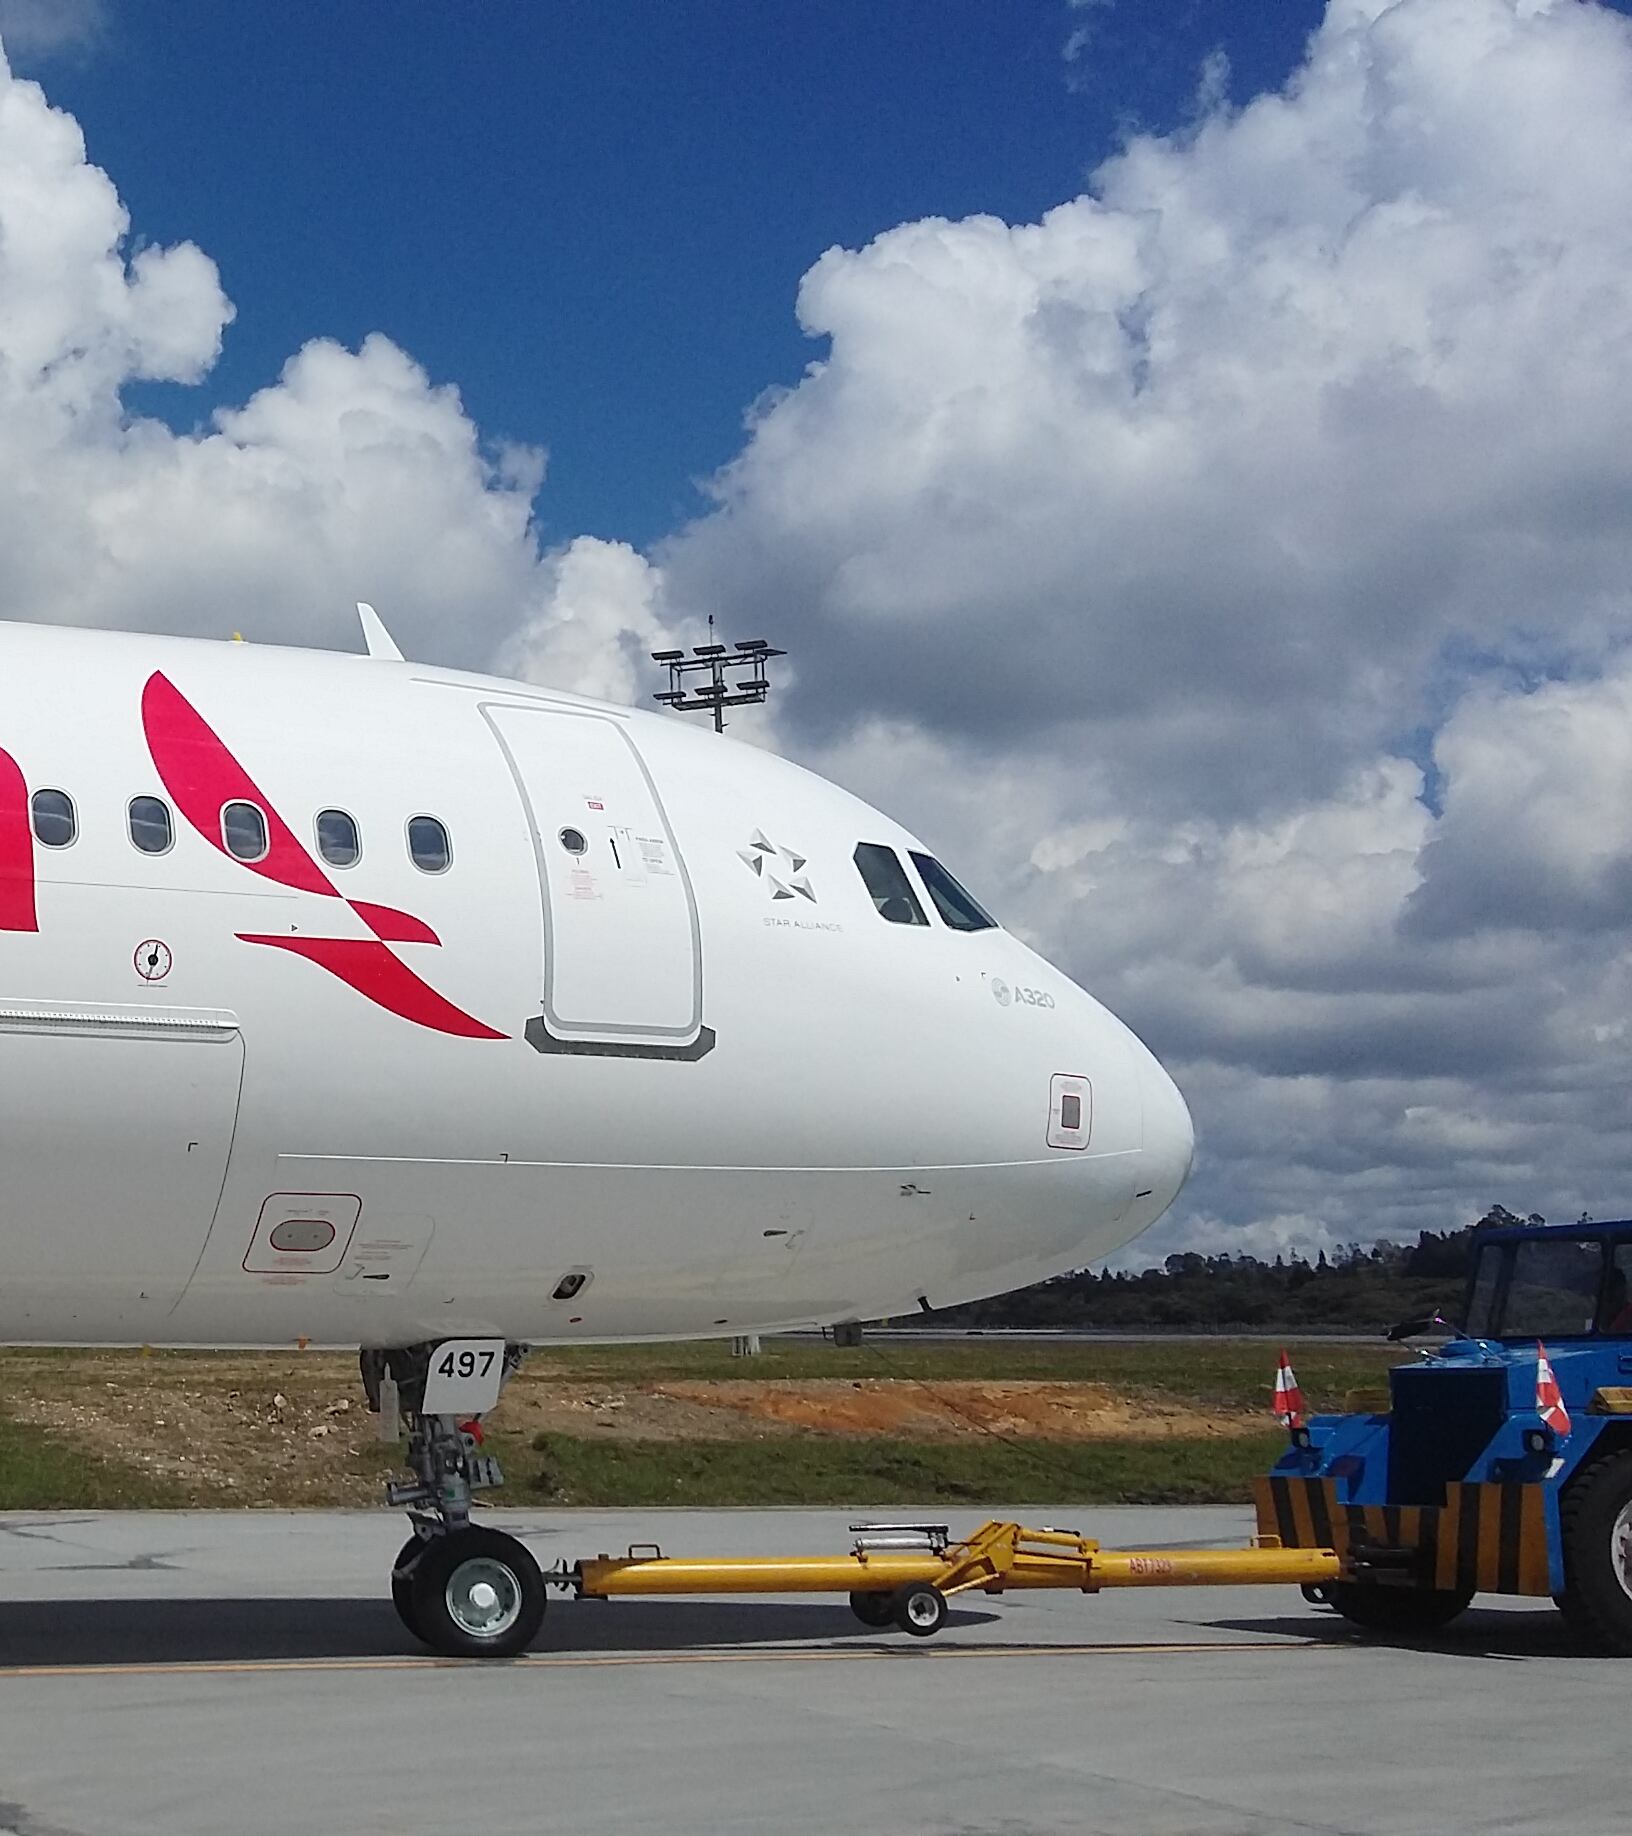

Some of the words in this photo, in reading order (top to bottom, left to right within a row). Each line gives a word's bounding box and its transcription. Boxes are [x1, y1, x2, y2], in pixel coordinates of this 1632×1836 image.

[763, 917, 790, 928] STAR
[794, 920, 844, 933] ALLIANCE
[1014, 986, 1056, 1010] A320
[438, 1351, 495, 1378] 497
